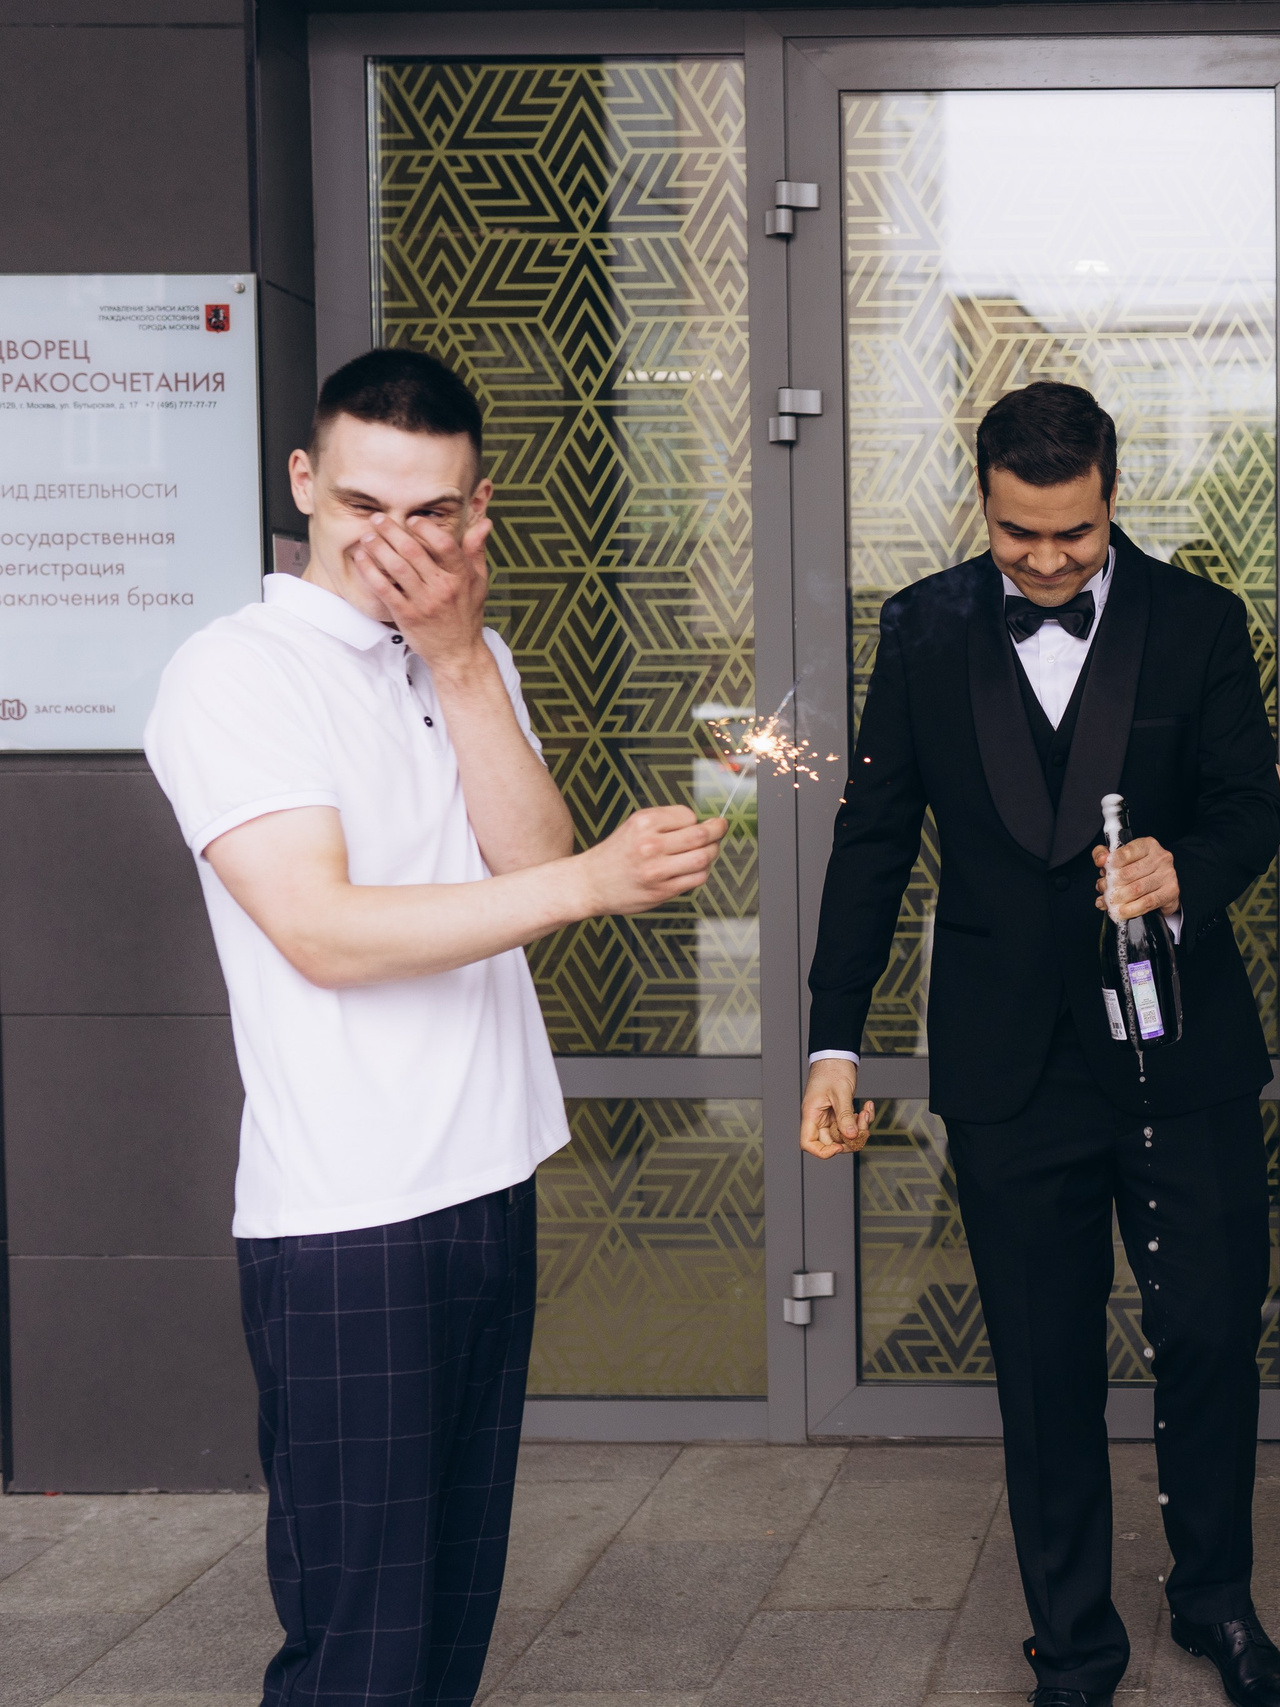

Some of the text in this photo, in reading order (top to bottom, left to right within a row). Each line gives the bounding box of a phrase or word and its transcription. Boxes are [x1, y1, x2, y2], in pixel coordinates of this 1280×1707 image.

[1, 372, 226, 393] РАКОСОЧЕТАНИЯ
[156, 401, 177, 410] (495)
[178, 401, 217, 409] 777-77-77
[1, 483, 179, 502] ИД ДЕЯТЕЛЬНОСТИ
[1, 531, 176, 552] осударственная
[0, 586, 194, 611] аключения брака
[34, 704, 116, 714] ЗАГС МОСКВЫ
